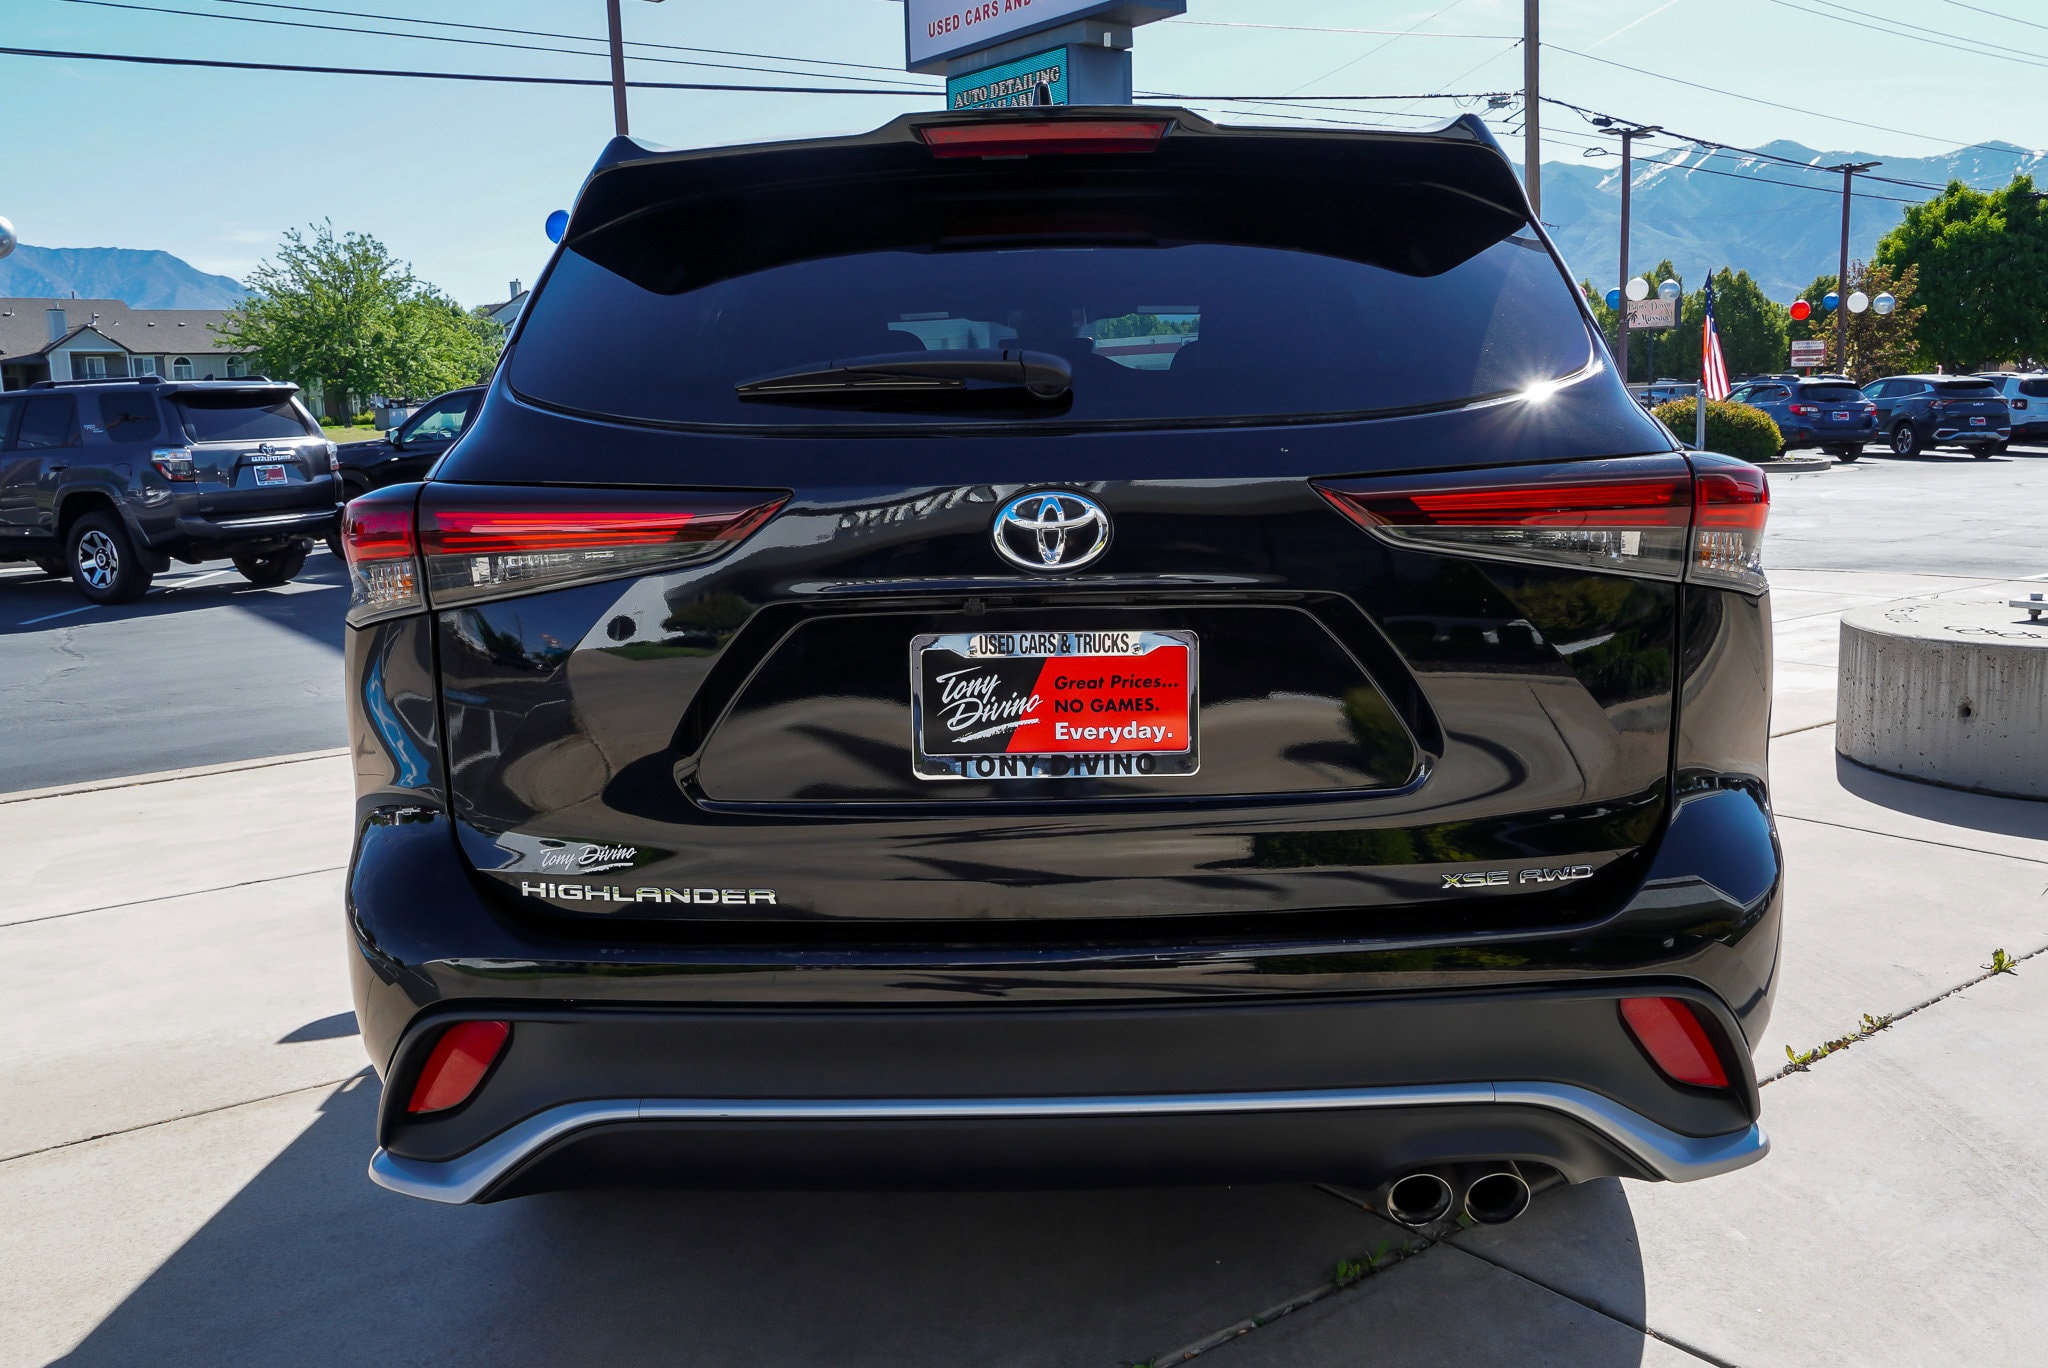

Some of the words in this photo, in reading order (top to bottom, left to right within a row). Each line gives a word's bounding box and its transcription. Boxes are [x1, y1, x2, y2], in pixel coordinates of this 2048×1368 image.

[928, 14, 960, 38] USED
[965, 0, 999, 26] CARS
[954, 86, 988, 109] AUTO
[989, 65, 1060, 99] DETAILING
[979, 634, 1015, 655] USED
[1020, 633, 1057, 655] CARS
[1061, 634, 1071, 654] &
[1075, 633, 1130, 654] TRUCKS
[935, 665, 1002, 704] Tony
[1054, 675, 1104, 690] Great
[1110, 674, 1179, 690] Prices...
[937, 692, 1044, 731] Divino
[1054, 699, 1085, 714] NO
[1089, 698, 1160, 714] GAMES.
[1055, 720, 1174, 745] Everyday.
[958, 755, 1037, 777] TONY
[1050, 753, 1157, 776] DIVINO
[539, 846, 578, 871] Tony
[578, 843, 637, 865] Divino
[1441, 870, 1510, 889] XSE
[1519, 864, 1594, 884] AWD
[521, 881, 777, 905] HIGHLANDER
